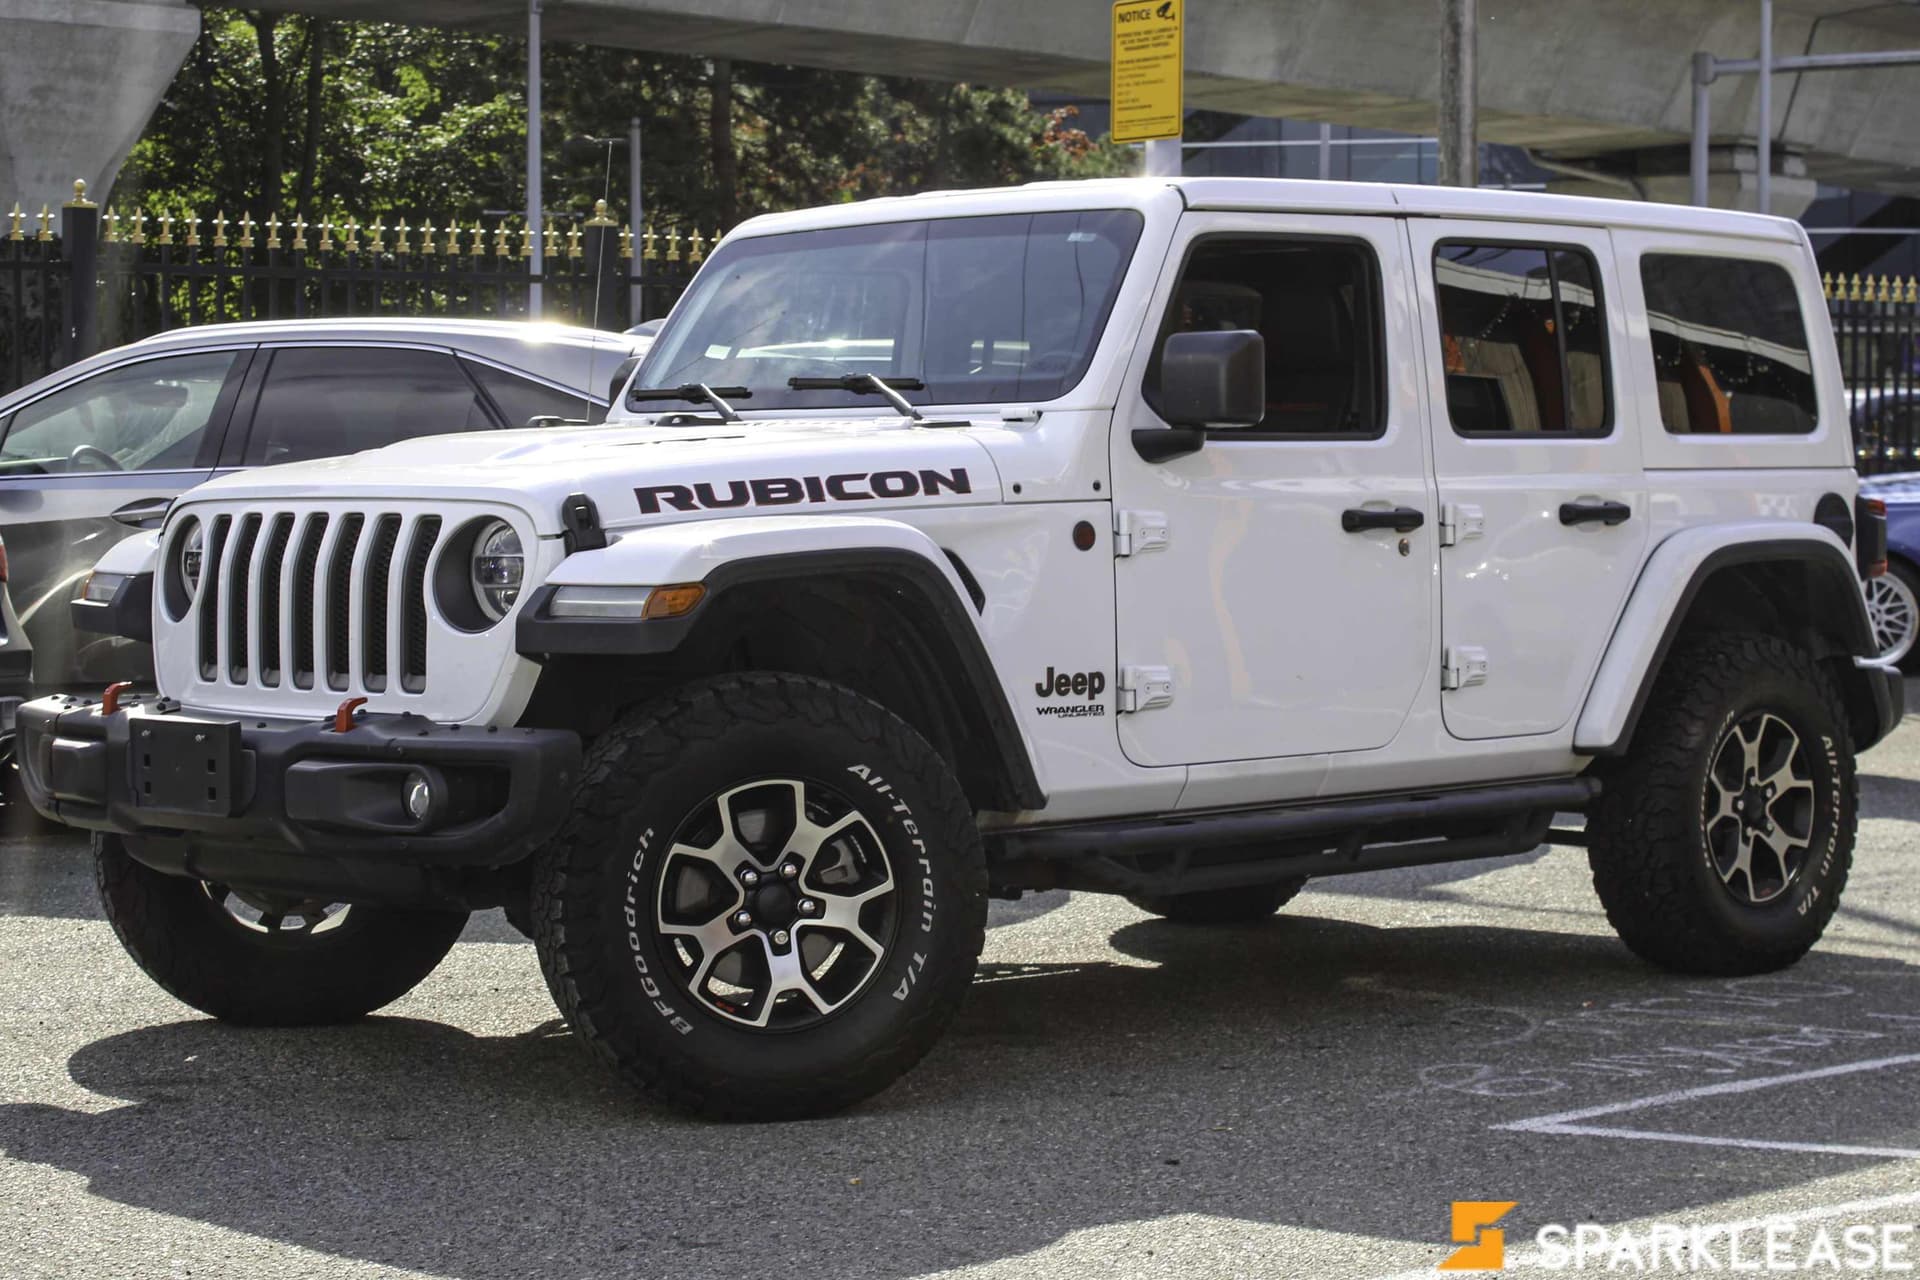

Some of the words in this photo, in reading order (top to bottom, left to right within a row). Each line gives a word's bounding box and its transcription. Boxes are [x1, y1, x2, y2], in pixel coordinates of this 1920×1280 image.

[1118, 8, 1152, 24] NOTICE
[633, 468, 972, 514] RUBICON
[1035, 666, 1105, 700] Jeep
[1036, 704, 1104, 715] WRANGLER
[847, 763, 937, 932] All-Terrain
[892, 951, 927, 1001] T/A
[624, 827, 693, 1035] BFGoodrich
